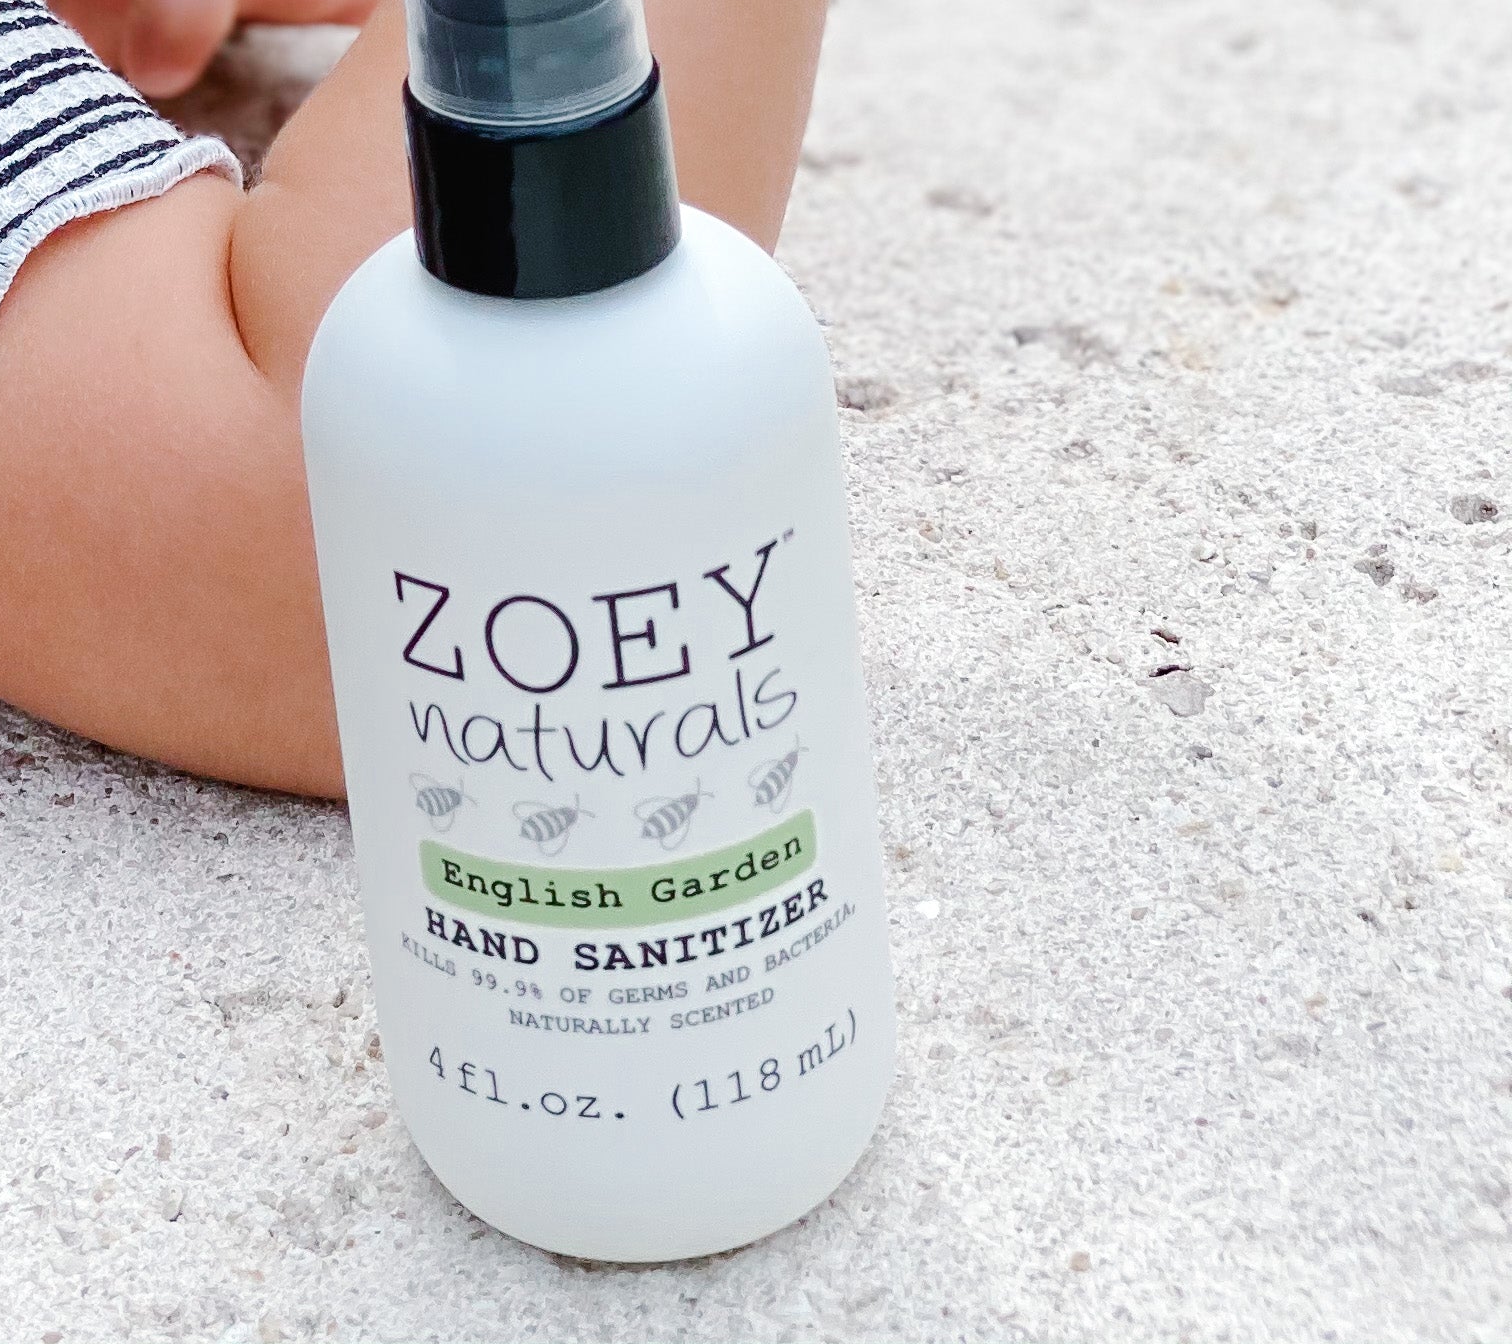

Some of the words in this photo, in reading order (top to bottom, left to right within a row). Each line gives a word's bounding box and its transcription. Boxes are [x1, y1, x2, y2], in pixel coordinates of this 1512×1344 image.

[393, 538, 779, 694] ZOEY
[409, 668, 798, 781] naturals
[440, 858, 624, 909] English
[650, 835, 803, 904] Garden
[424, 907, 540, 966] HAND
[573, 878, 831, 972] SANITIZER
[400, 931, 457, 977] KILLS
[471, 968, 544, 1000] 99.9%
[559, 986, 593, 1005] OF
[608, 981, 689, 1005] GERMS
[705, 964, 752, 994] AND
[507, 1008, 651, 1036] NATURALLY
[670, 986, 775, 1031] SCENTED
